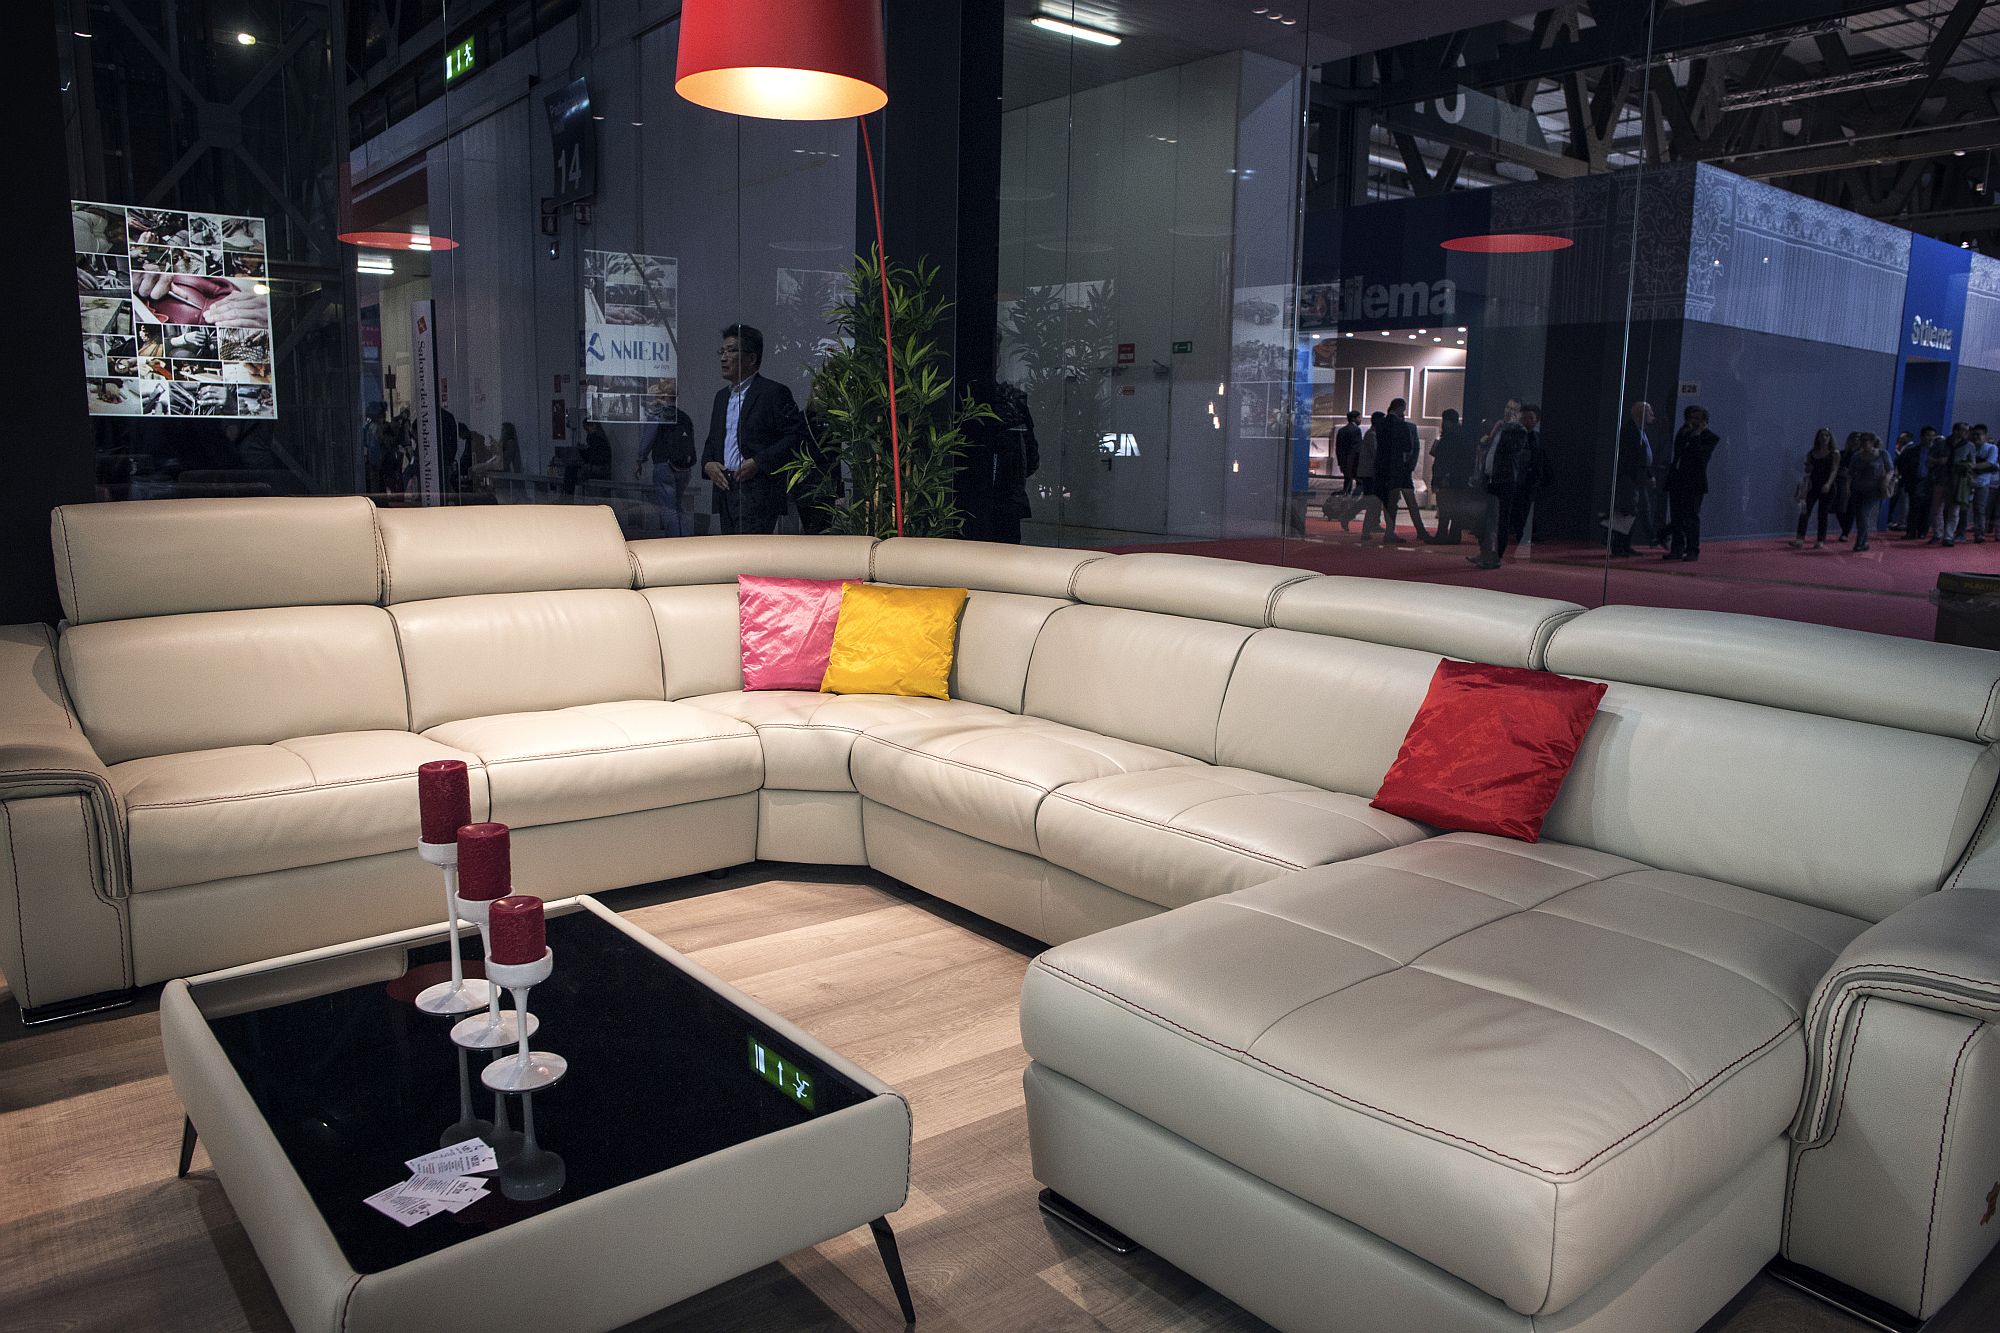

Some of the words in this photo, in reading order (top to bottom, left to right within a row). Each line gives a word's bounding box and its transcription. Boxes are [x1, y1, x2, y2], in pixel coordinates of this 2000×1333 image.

[557, 143, 582, 193] 14
[1911, 314, 1953, 350] Stilema
[417, 341, 426, 386] Salone
[419, 388, 428, 408] del
[423, 460, 432, 506] Milano
